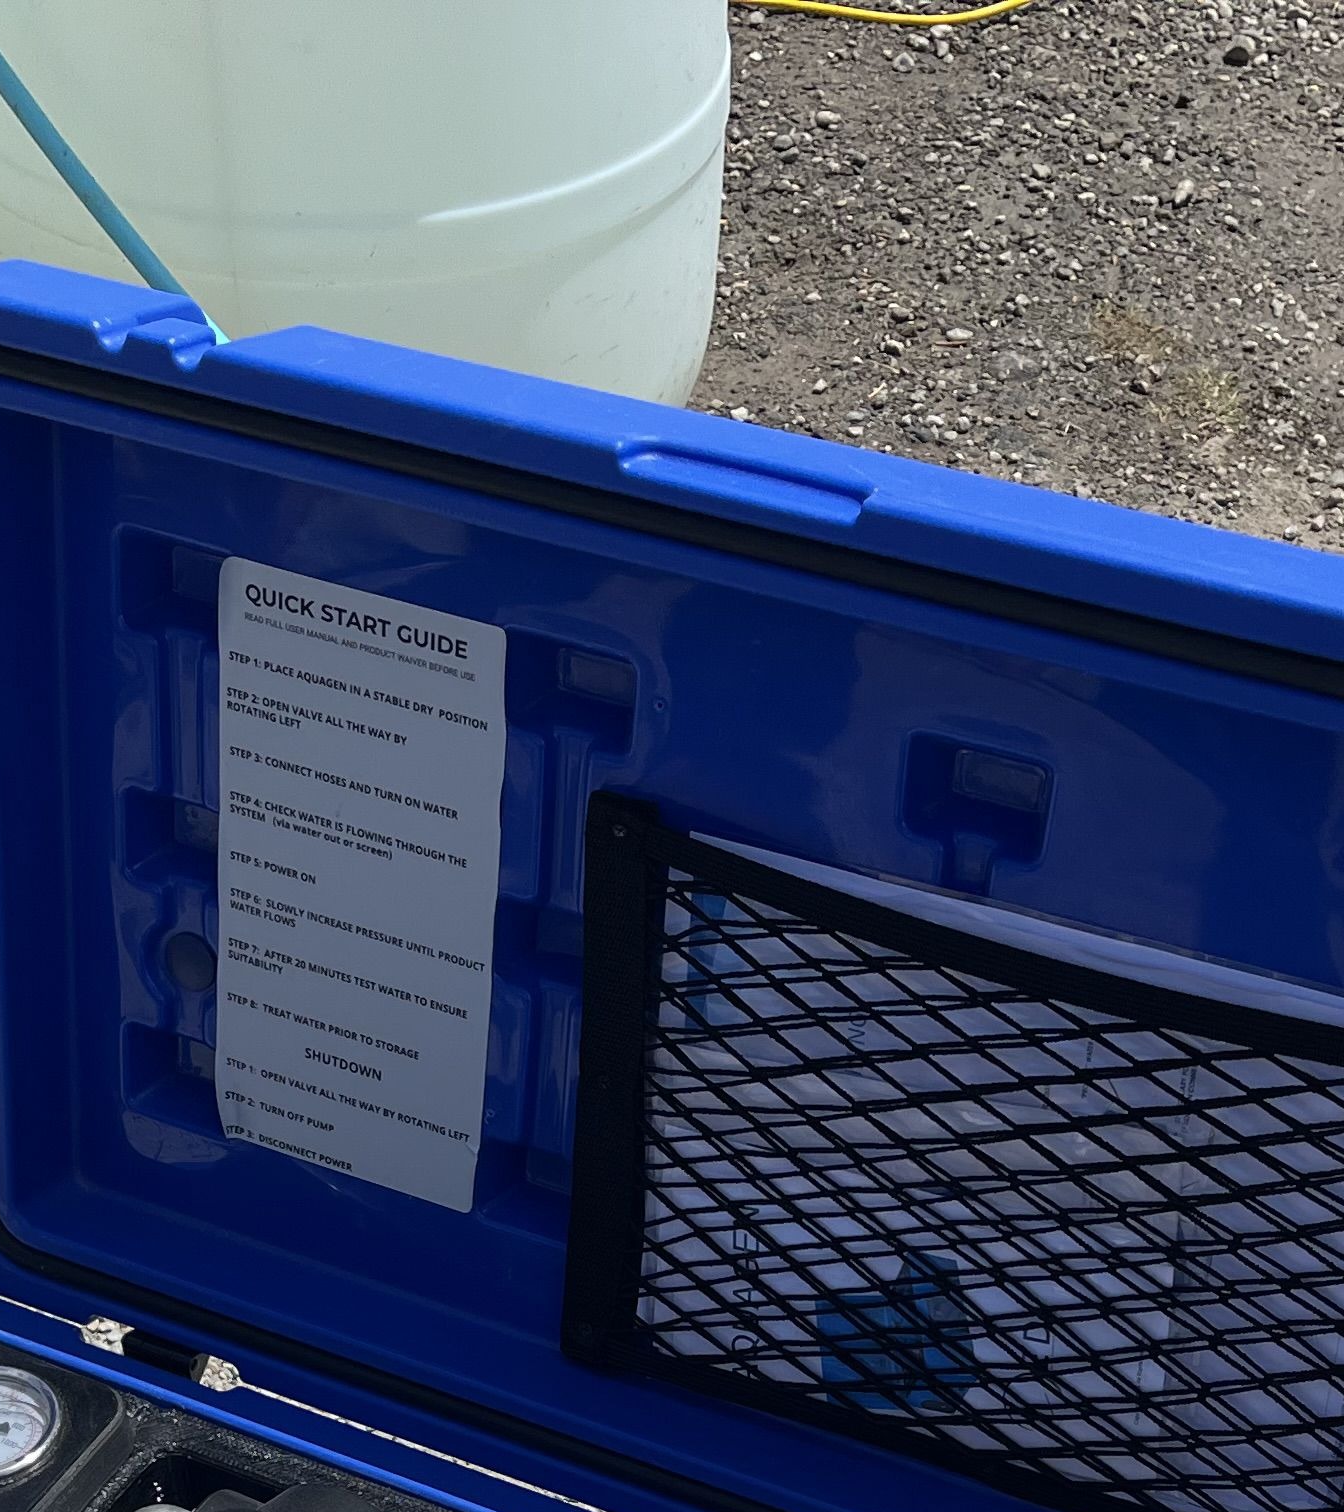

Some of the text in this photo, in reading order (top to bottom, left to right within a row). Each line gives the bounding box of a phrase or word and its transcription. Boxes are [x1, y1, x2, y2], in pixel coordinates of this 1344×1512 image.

[244, 611, 475, 681] READ FULL USER MANUAL AND PRODUCT WAIVER BEFORE USE
[245, 583, 467, 659] QUICK START GUIDE
[226, 700, 301, 729] ROTATING LEFT
[226, 686, 406, 745] STEP 2: OPEN VALVE ALL THE WAY BY
[228, 650, 487, 731] STEP 1: PLACE AQUAGEN IN A STABLE DRY POSITION
[229, 745, 457, 820] STEP 3: CONNECT HOSES AND TURN ON WATER
[229, 790, 466, 868] STEP 4: CHECK WATER IS FLOWING THROUGH THE
[230, 803, 392, 860] SYSTEM (via water out or screen)
[230, 850, 315, 884] STEP 5: POWER ON
[230, 899, 295, 927] WATER FLOWS
[230, 887, 485, 971] STEP 6: SLOWLY INCREASE PRESSURE UNTIL PRODUCT
[228, 949, 283, 974] SUITABILITY
[228, 937, 467, 1019] STEP 7: AFTER 20 MINUTES TEST WATER TO ENSURE
[227, 992, 419, 1060] STEP 8: TREAT WATER PRIOR TO STORAGE
[304, 1047, 381, 1081] SHUTDOWN
[225, 1090, 333, 1131] STEP 2: TURN OFF PUMP
[226, 1057, 469, 1142] STEP 1: OPEN VALVE ALL THE WAY BY ROTATING LEFT
[226, 1125, 244, 1135] STEP
[258, 1133, 316, 1158] DISCONNECT
[319, 1153, 351, 1171] POWER
